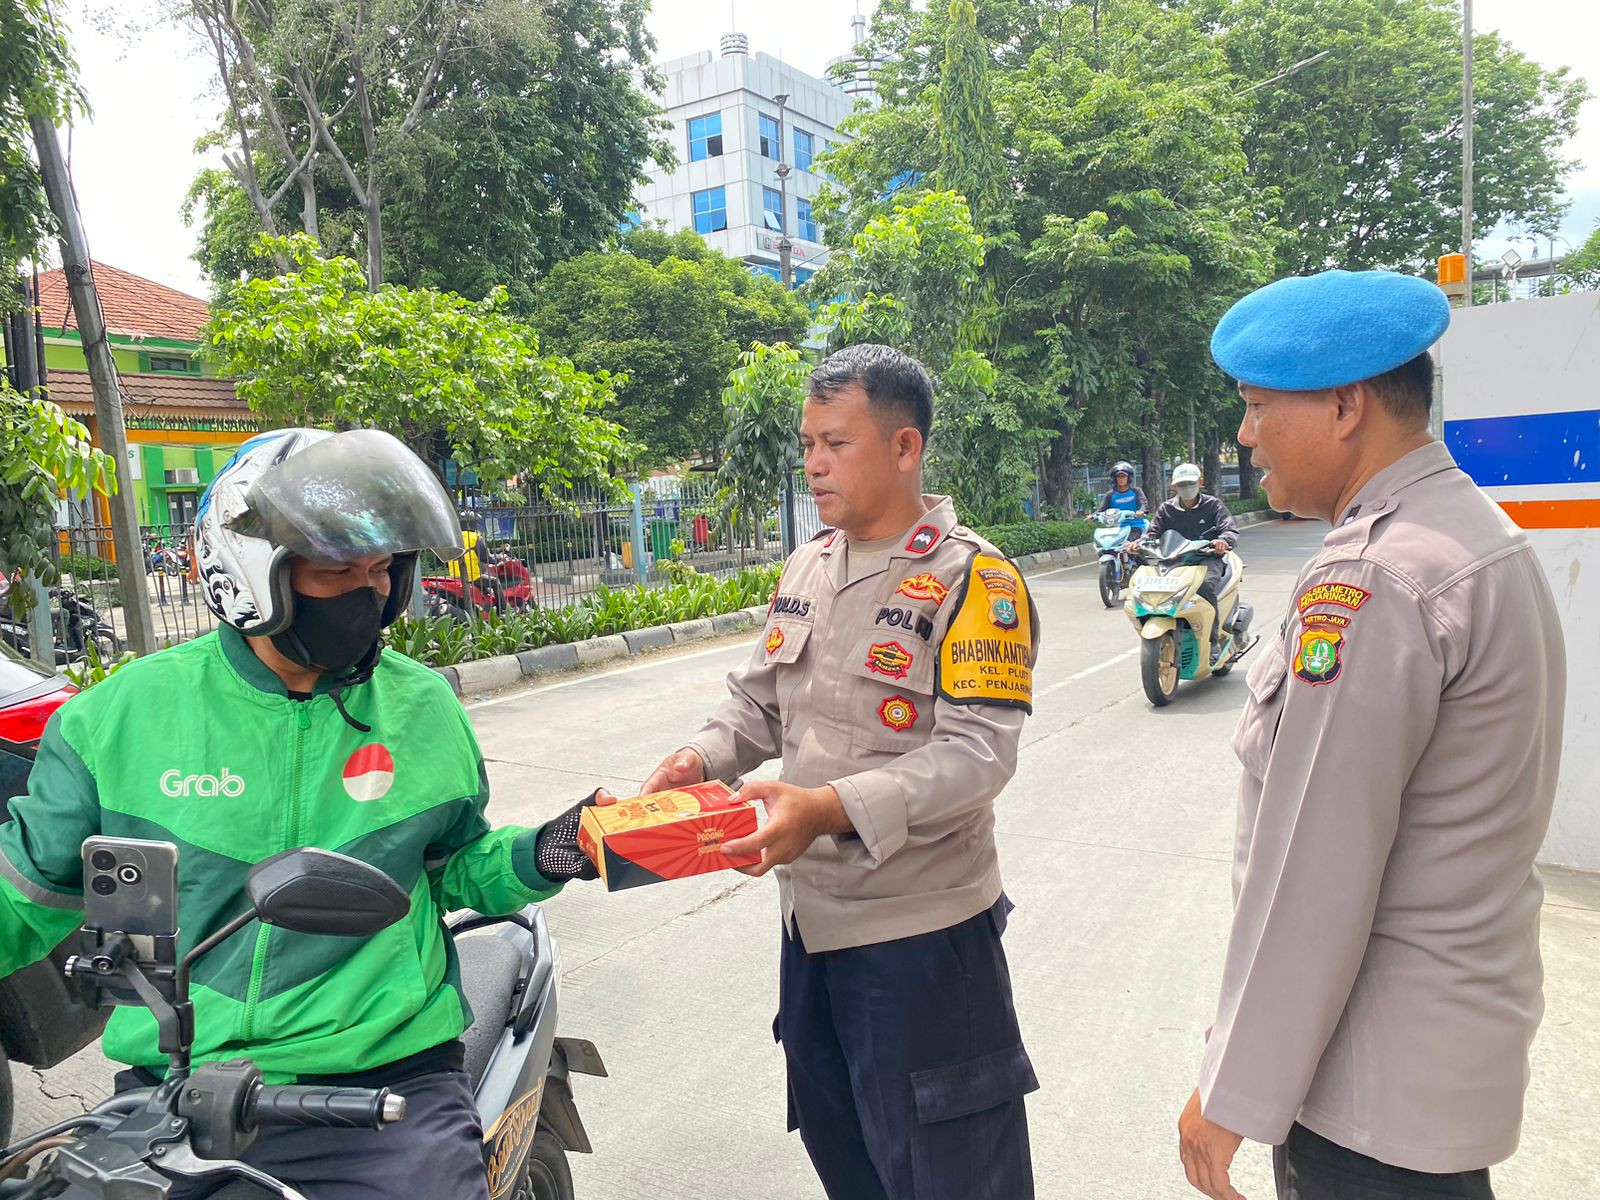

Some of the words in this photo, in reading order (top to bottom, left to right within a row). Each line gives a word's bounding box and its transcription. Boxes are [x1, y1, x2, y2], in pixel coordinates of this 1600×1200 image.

[1330, 585, 1363, 599] METRO
[980, 665, 1003, 676] KEL.
[1008, 667, 1029, 681] PLUIT
[953, 680, 981, 690] KEC.
[160, 767, 245, 797] Grab
